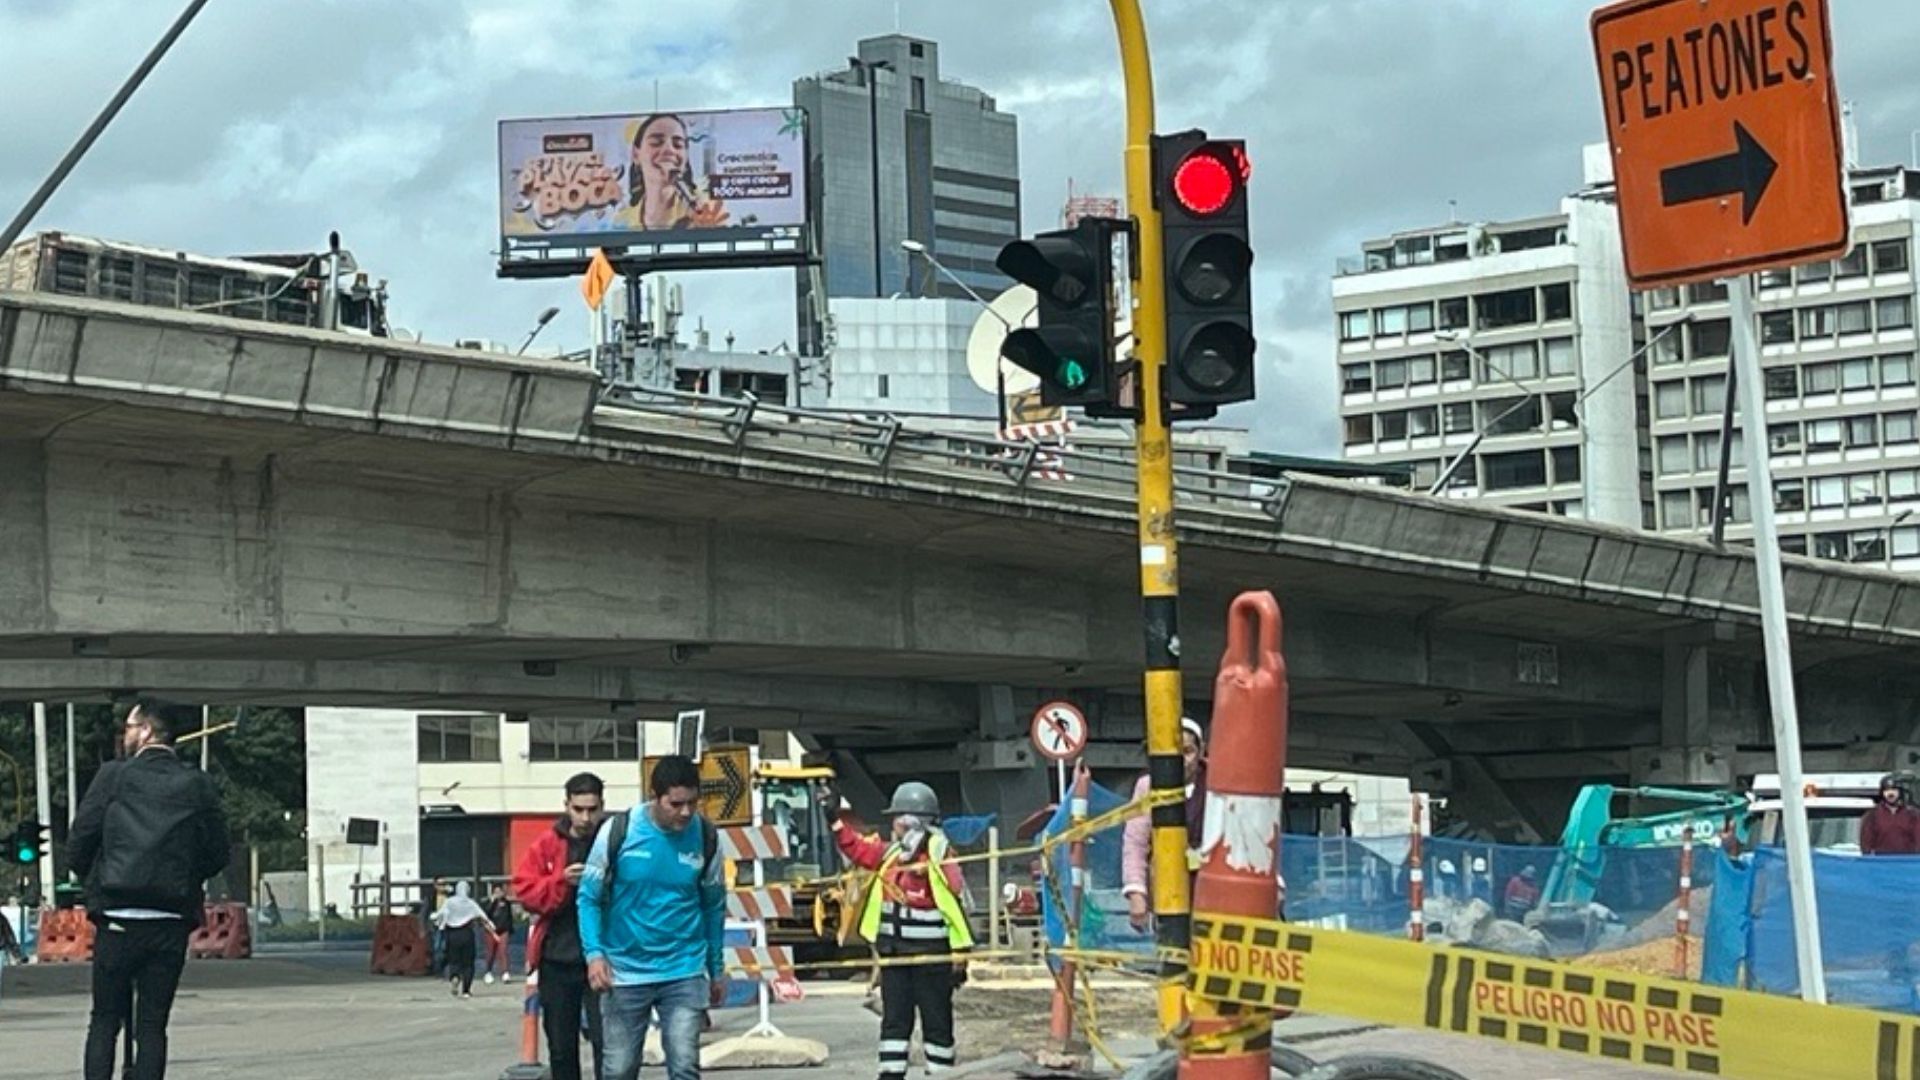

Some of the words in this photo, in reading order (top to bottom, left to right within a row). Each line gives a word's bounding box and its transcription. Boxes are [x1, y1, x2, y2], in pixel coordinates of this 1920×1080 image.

[1612, 0, 1810, 125] PEATONES
[1209, 942, 1240, 973] NO
[1247, 947, 1305, 983] PASE
[1475, 981, 1588, 1028] PELIGRO
[1595, 1000, 1636, 1036] NO
[1643, 1008, 1720, 1049] PASE
